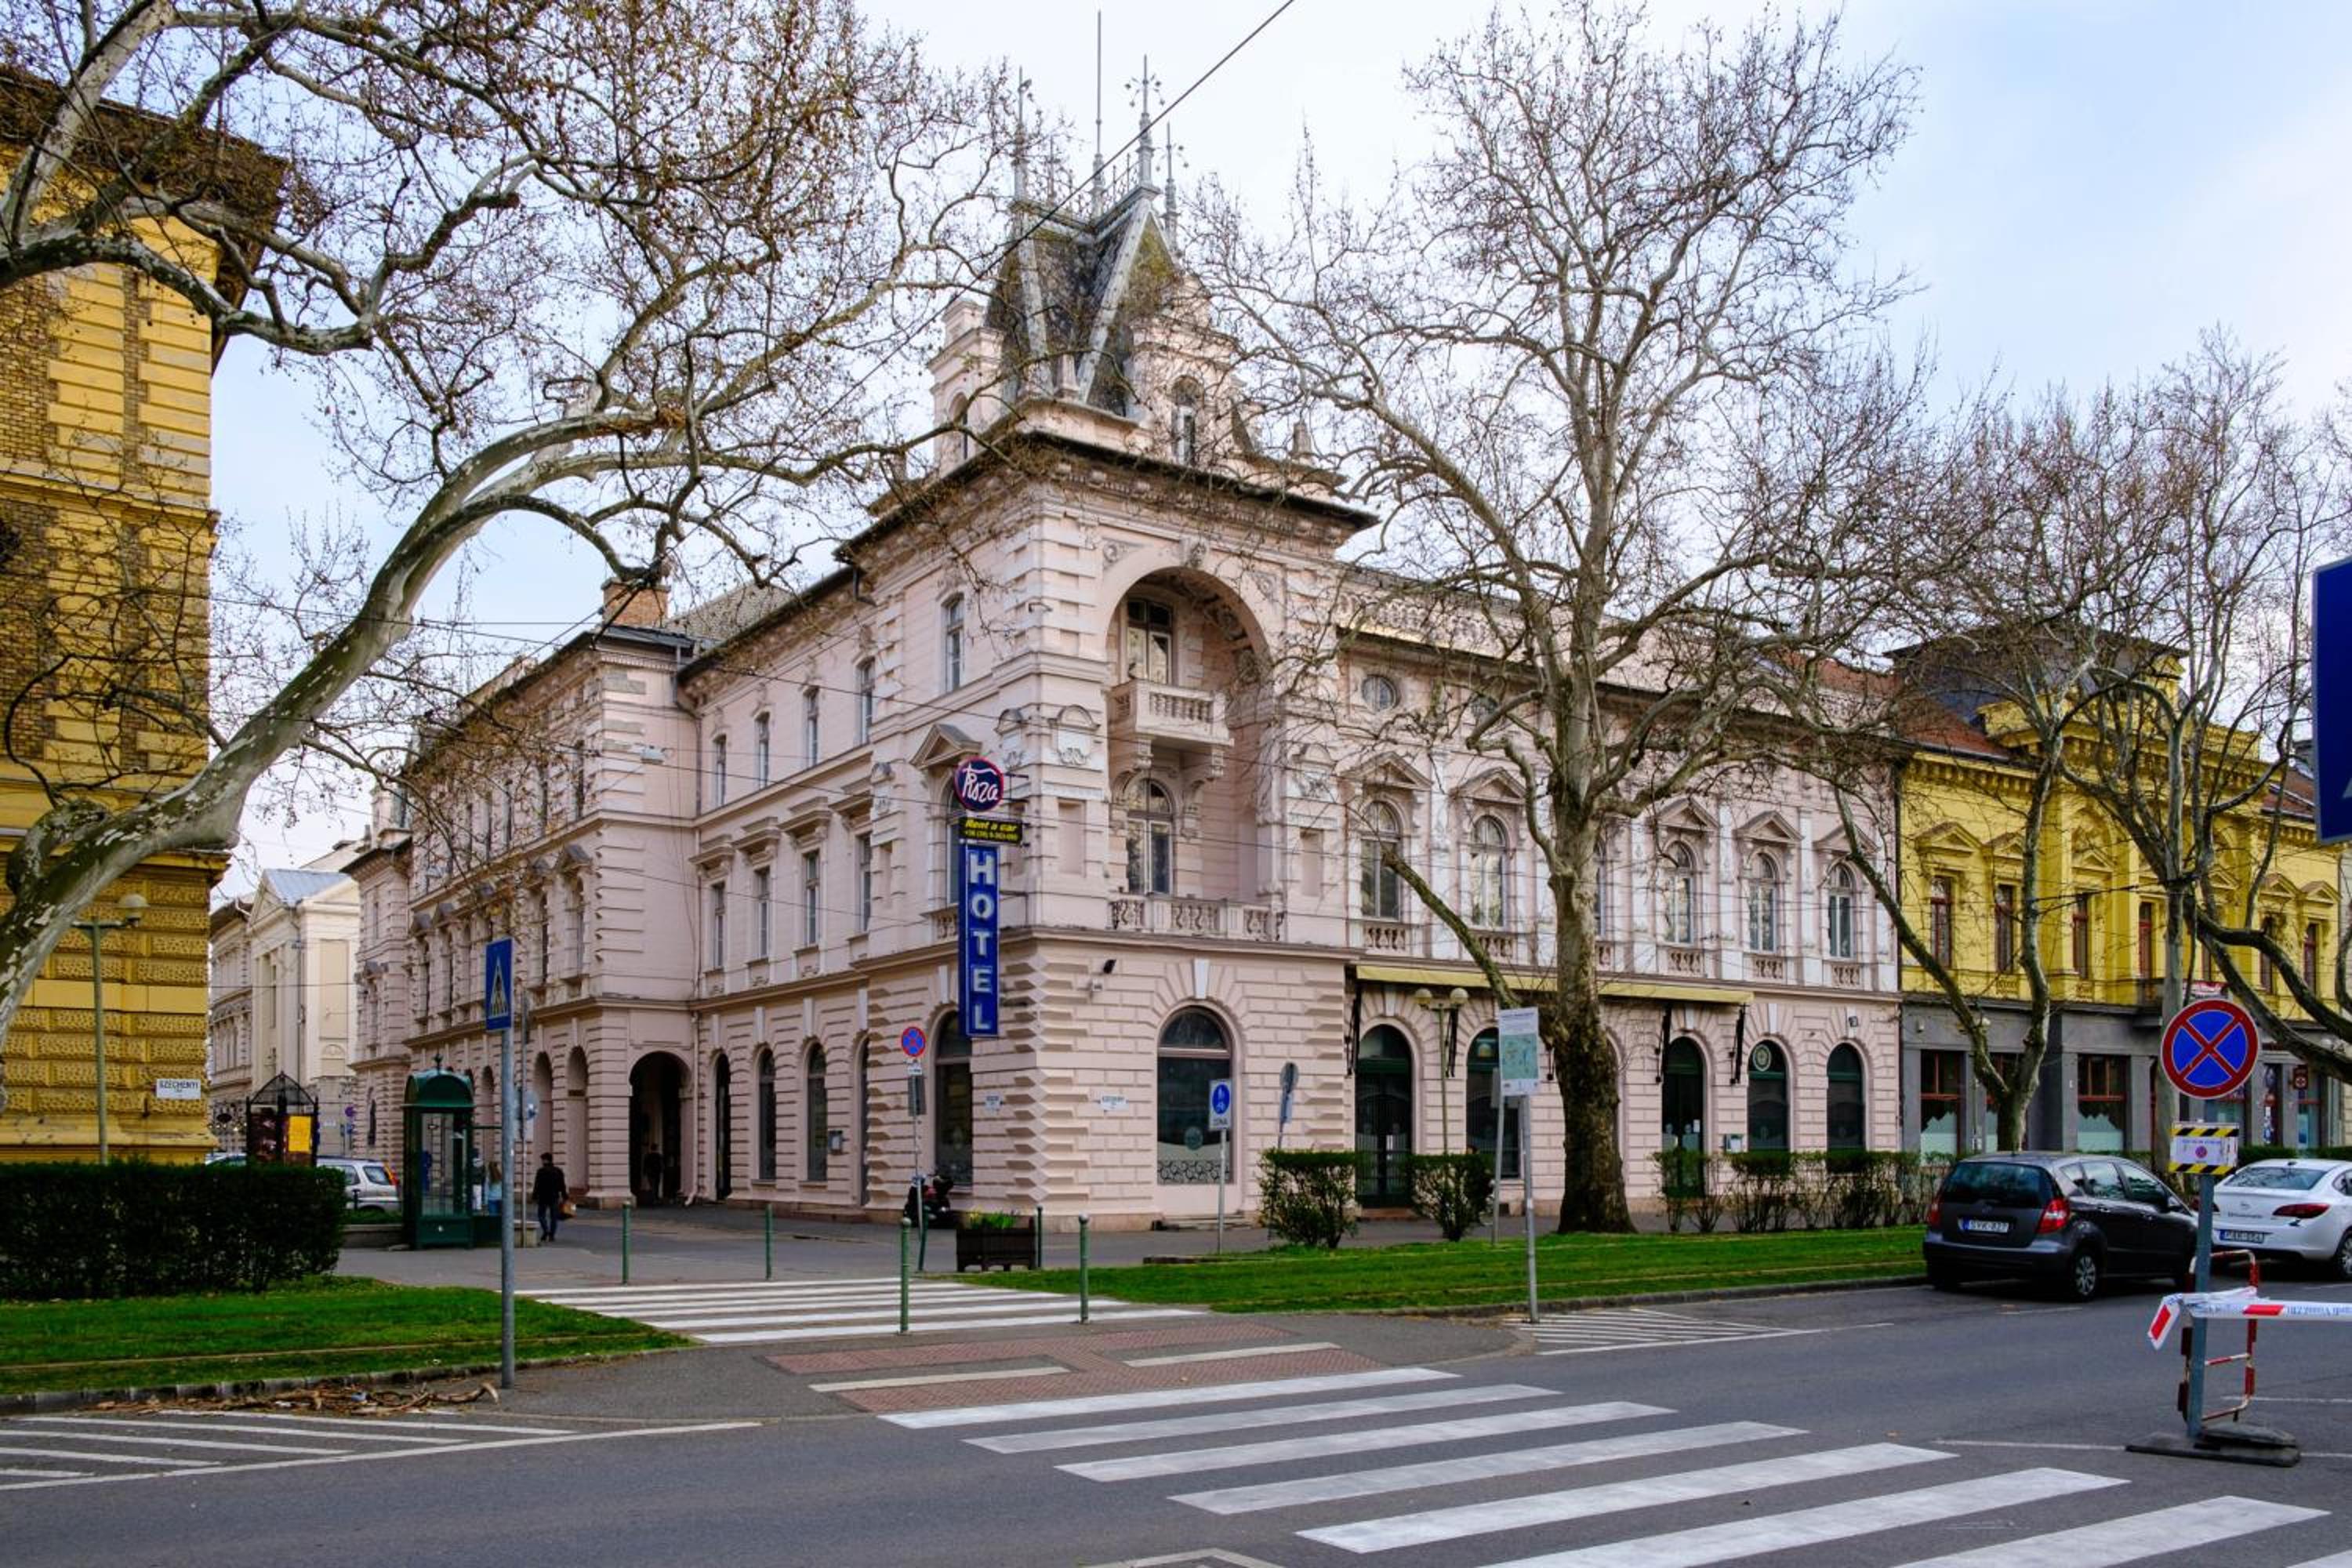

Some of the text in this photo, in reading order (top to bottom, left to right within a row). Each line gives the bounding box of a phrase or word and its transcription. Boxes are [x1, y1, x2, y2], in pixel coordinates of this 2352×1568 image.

[965, 818, 989, 829] Rent
[1000, 823, 1018, 832] car
[969, 851, 996, 1030] HOTEL
